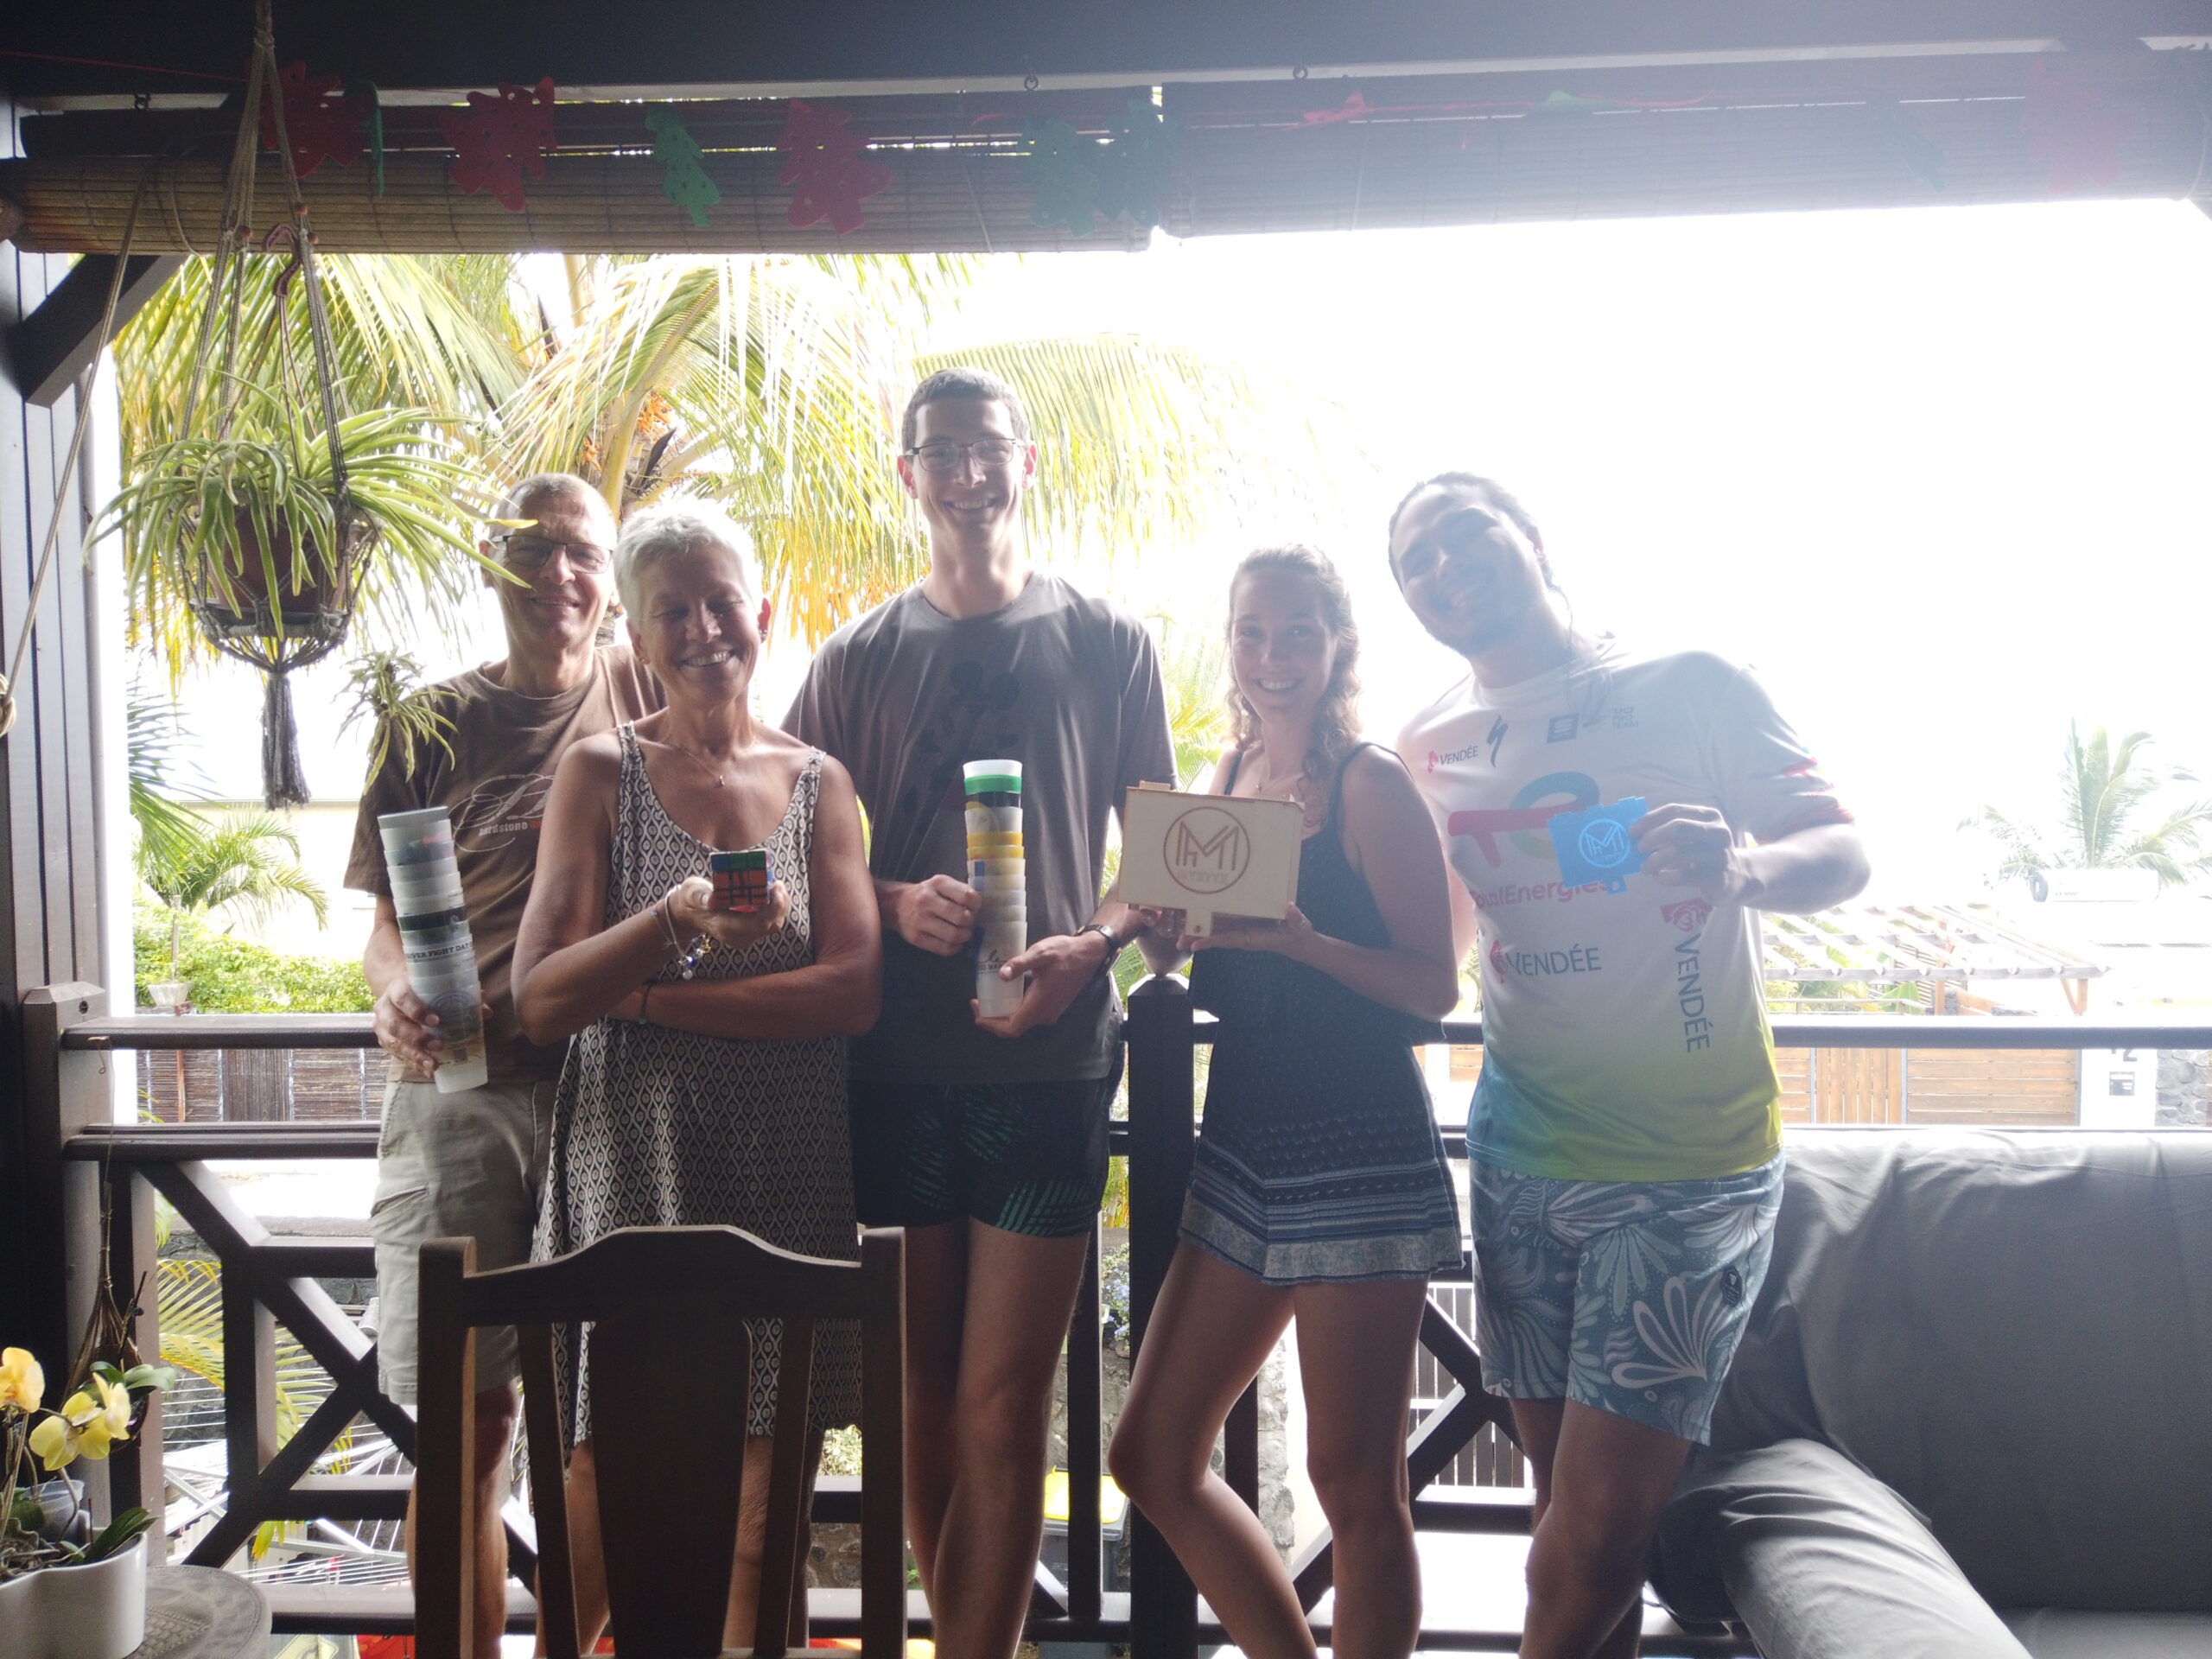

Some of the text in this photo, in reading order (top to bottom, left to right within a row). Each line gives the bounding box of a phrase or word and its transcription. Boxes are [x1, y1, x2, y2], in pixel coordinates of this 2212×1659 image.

[1612, 720, 1639, 729] TEAM
[1440, 745, 1479, 766] VENDÉE
[1505, 943, 1603, 976] VENDÉE
[1675, 932, 1713, 1053] VENDÉE
